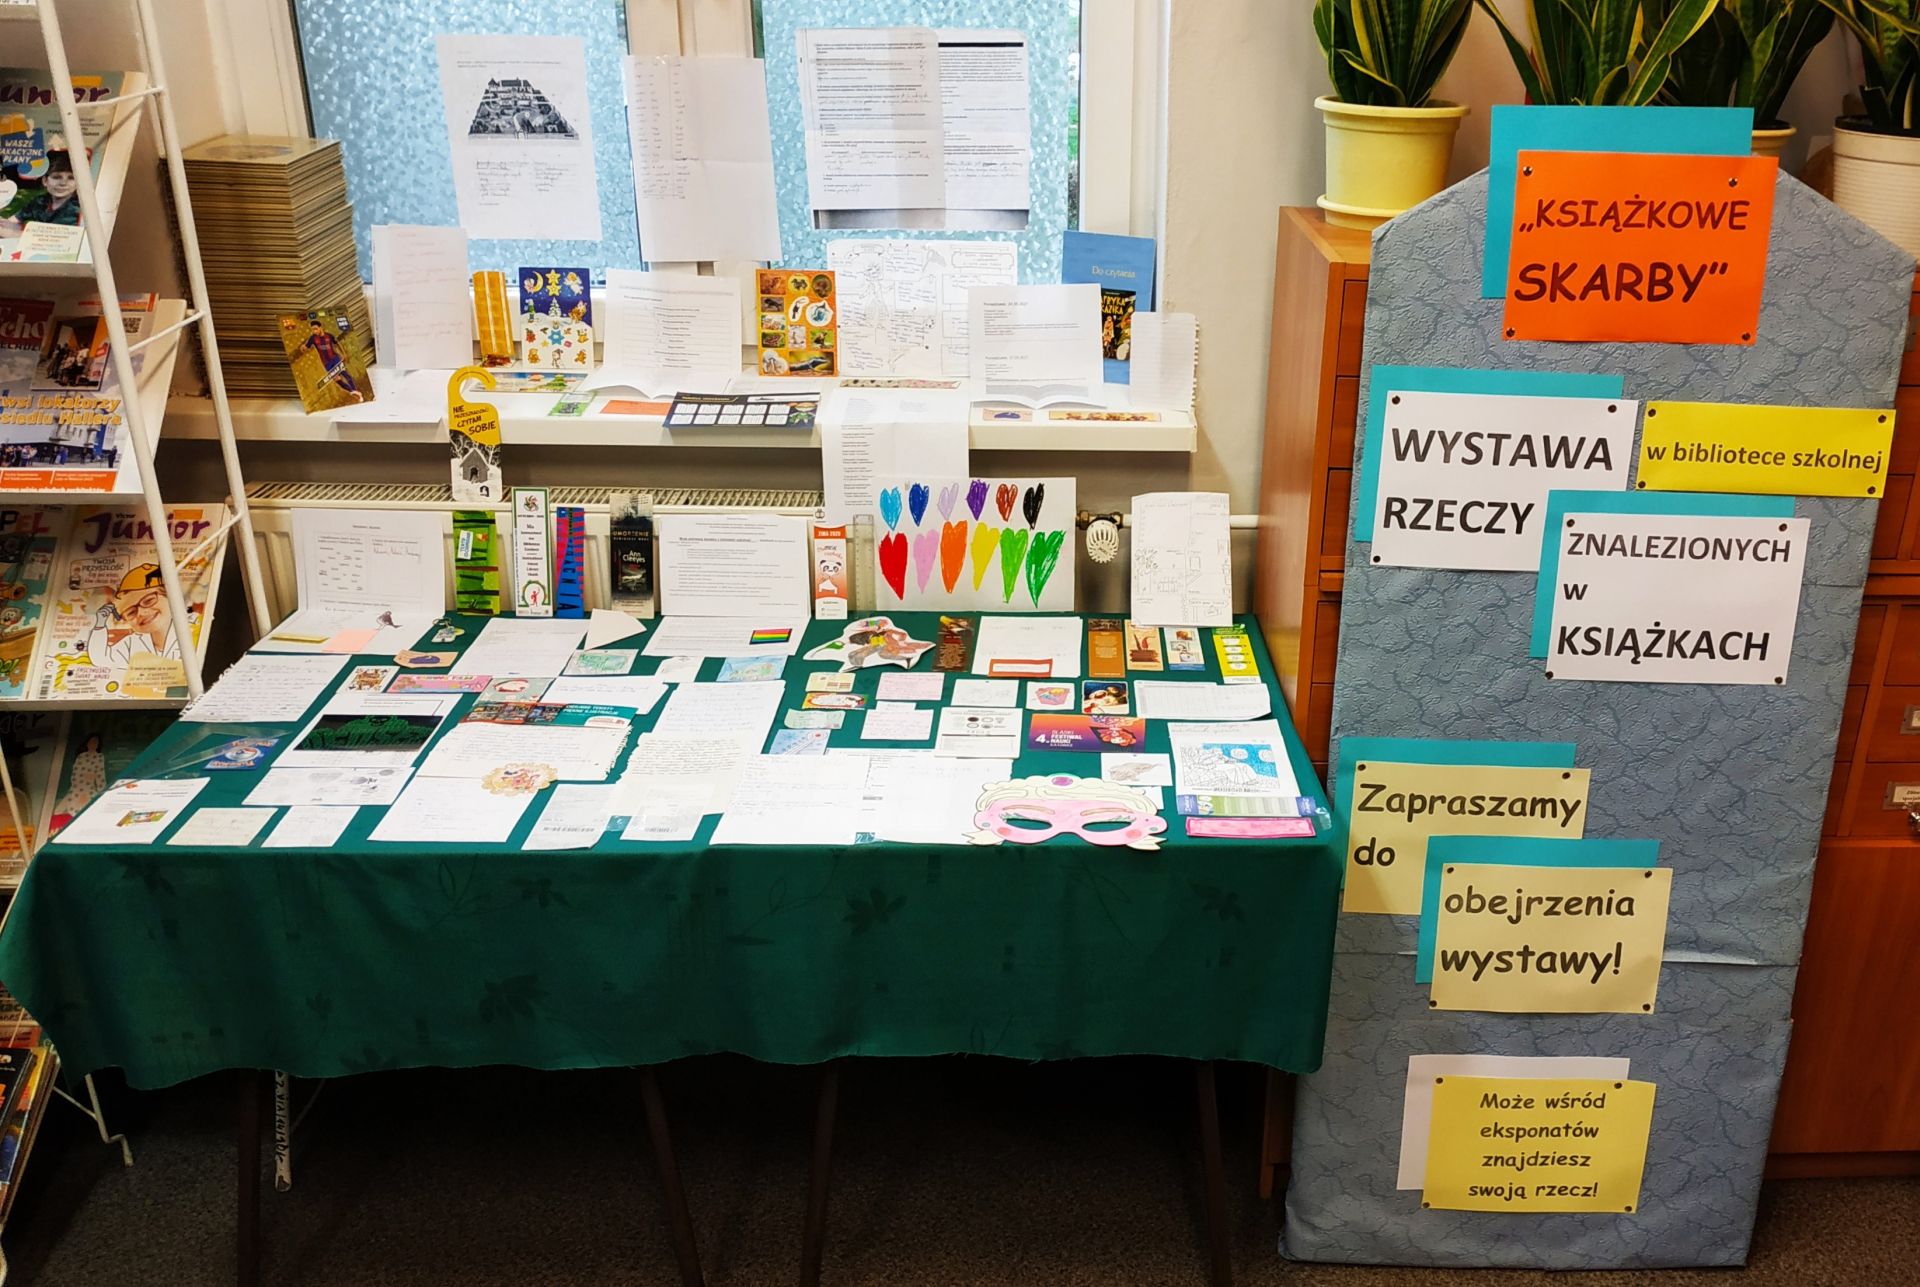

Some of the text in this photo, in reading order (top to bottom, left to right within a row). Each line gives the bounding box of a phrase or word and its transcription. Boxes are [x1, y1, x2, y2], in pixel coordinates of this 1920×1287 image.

[0, 85, 111, 106] unor
[0, 148, 43, 157] AKACYJNE
[5, 139, 34, 148] WASZE
[1518, 194, 1751, 234] „KSIĄŻKOWE
[1514, 261, 1729, 303] SKARBY”
[0, 397, 32, 409] wsi
[0, 410, 53, 425] siedlu
[469, 421, 496, 435] SOBIE
[1391, 427, 1613, 471] WYSTAWA
[1647, 441, 1883, 474] w bibliotece szkolnej
[1382, 497, 1535, 535] RZECZY
[1567, 532, 1791, 564] ZNALEZIONYCH
[1563, 582, 1588, 600] w
[1557, 621, 1770, 665] KSIĄŻKACH
[1357, 783, 1582, 827] Zapraszamy
[1353, 838, 1396, 867] do
[1444, 887, 1635, 924] obejrzenia
[1440, 942, 1623, 984] wystawy!
[1480, 1091, 1606, 1111] Może wśród
[1480, 1121, 1599, 1142] eksponatów
[1481, 1150, 1592, 1171] znajdziesz
[1468, 1181, 1598, 1201] swoją rzecz!
